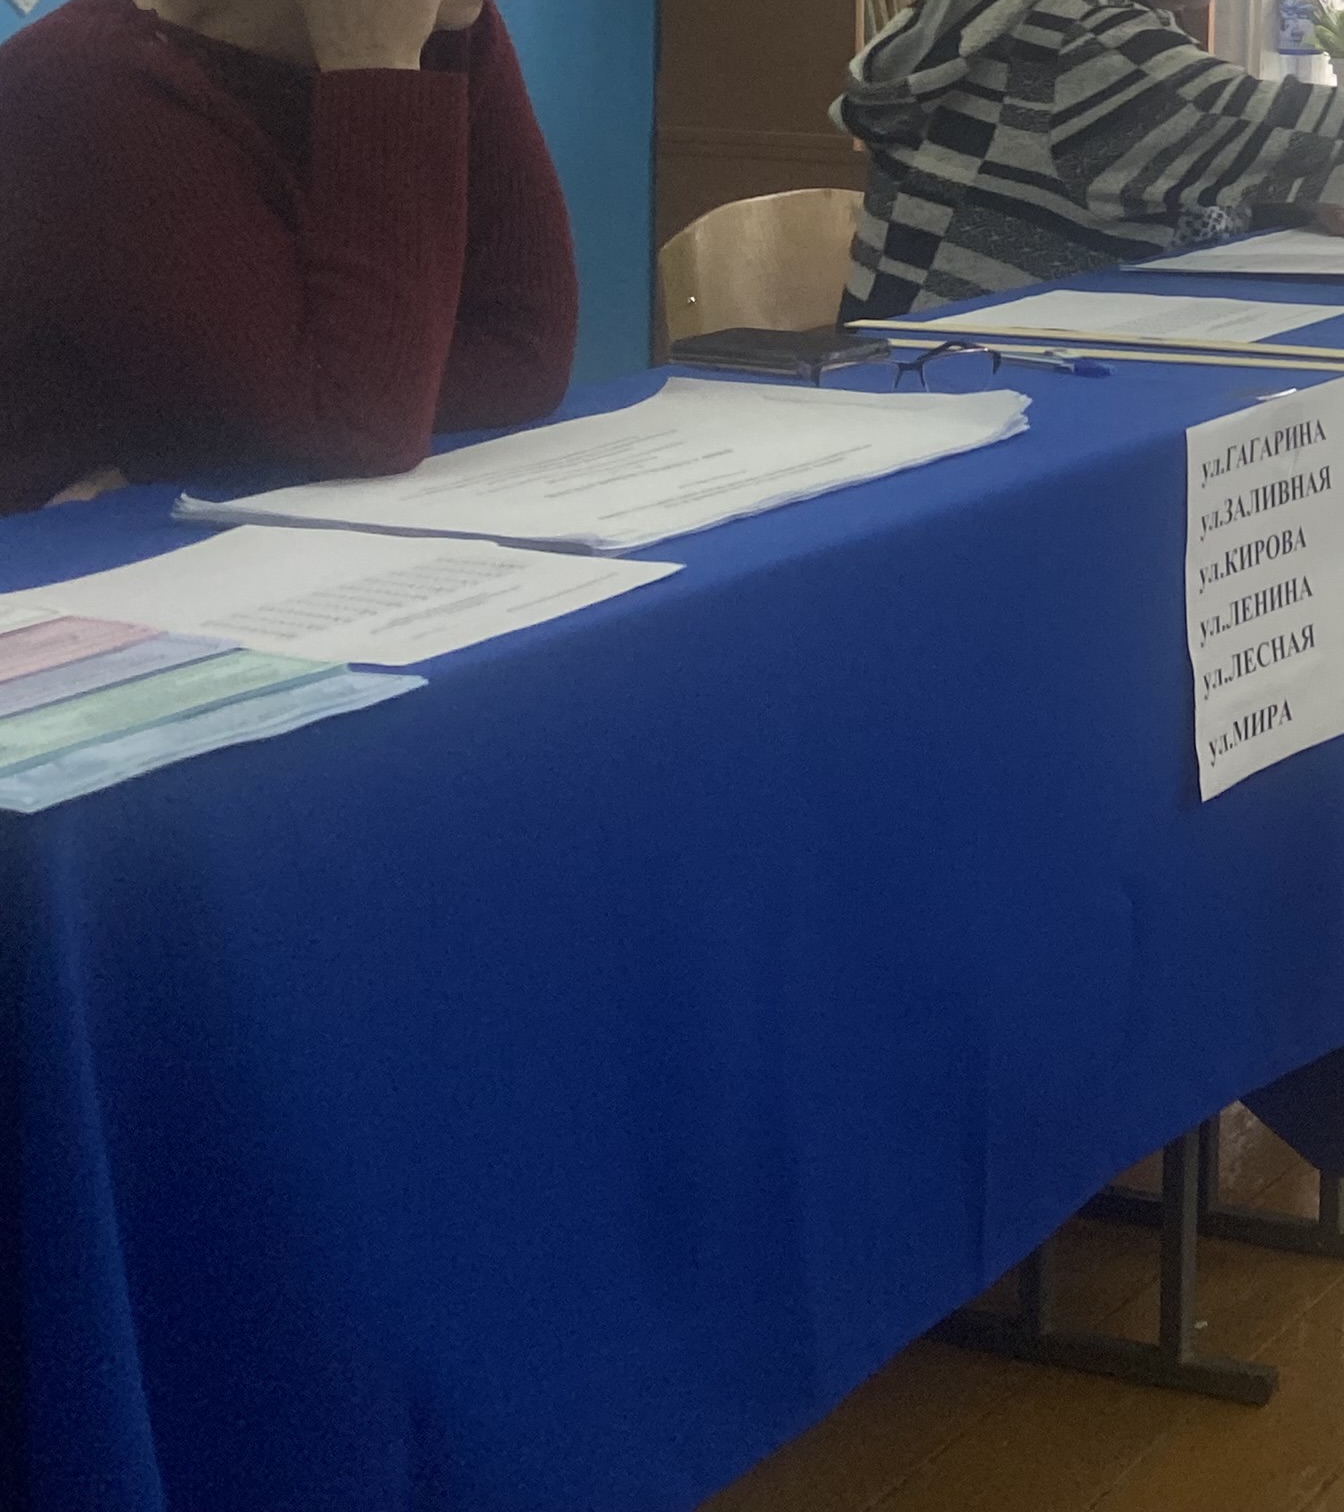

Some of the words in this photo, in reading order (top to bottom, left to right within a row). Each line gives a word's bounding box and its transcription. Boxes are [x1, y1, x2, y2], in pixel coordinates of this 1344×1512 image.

[1202, 419, 1327, 489] ул.ГАГАРИНА
[1200, 465, 1332, 541] ул.ЗАЛИВНАЯ
[1199, 525, 1307, 594] ул.КИРОВА
[1200, 575, 1313, 648] ул.ЛЕНИНА
[1203, 624, 1315, 700] ул.ЛЕСНАЯ
[1209, 699, 1293, 767] ул.МИРА
